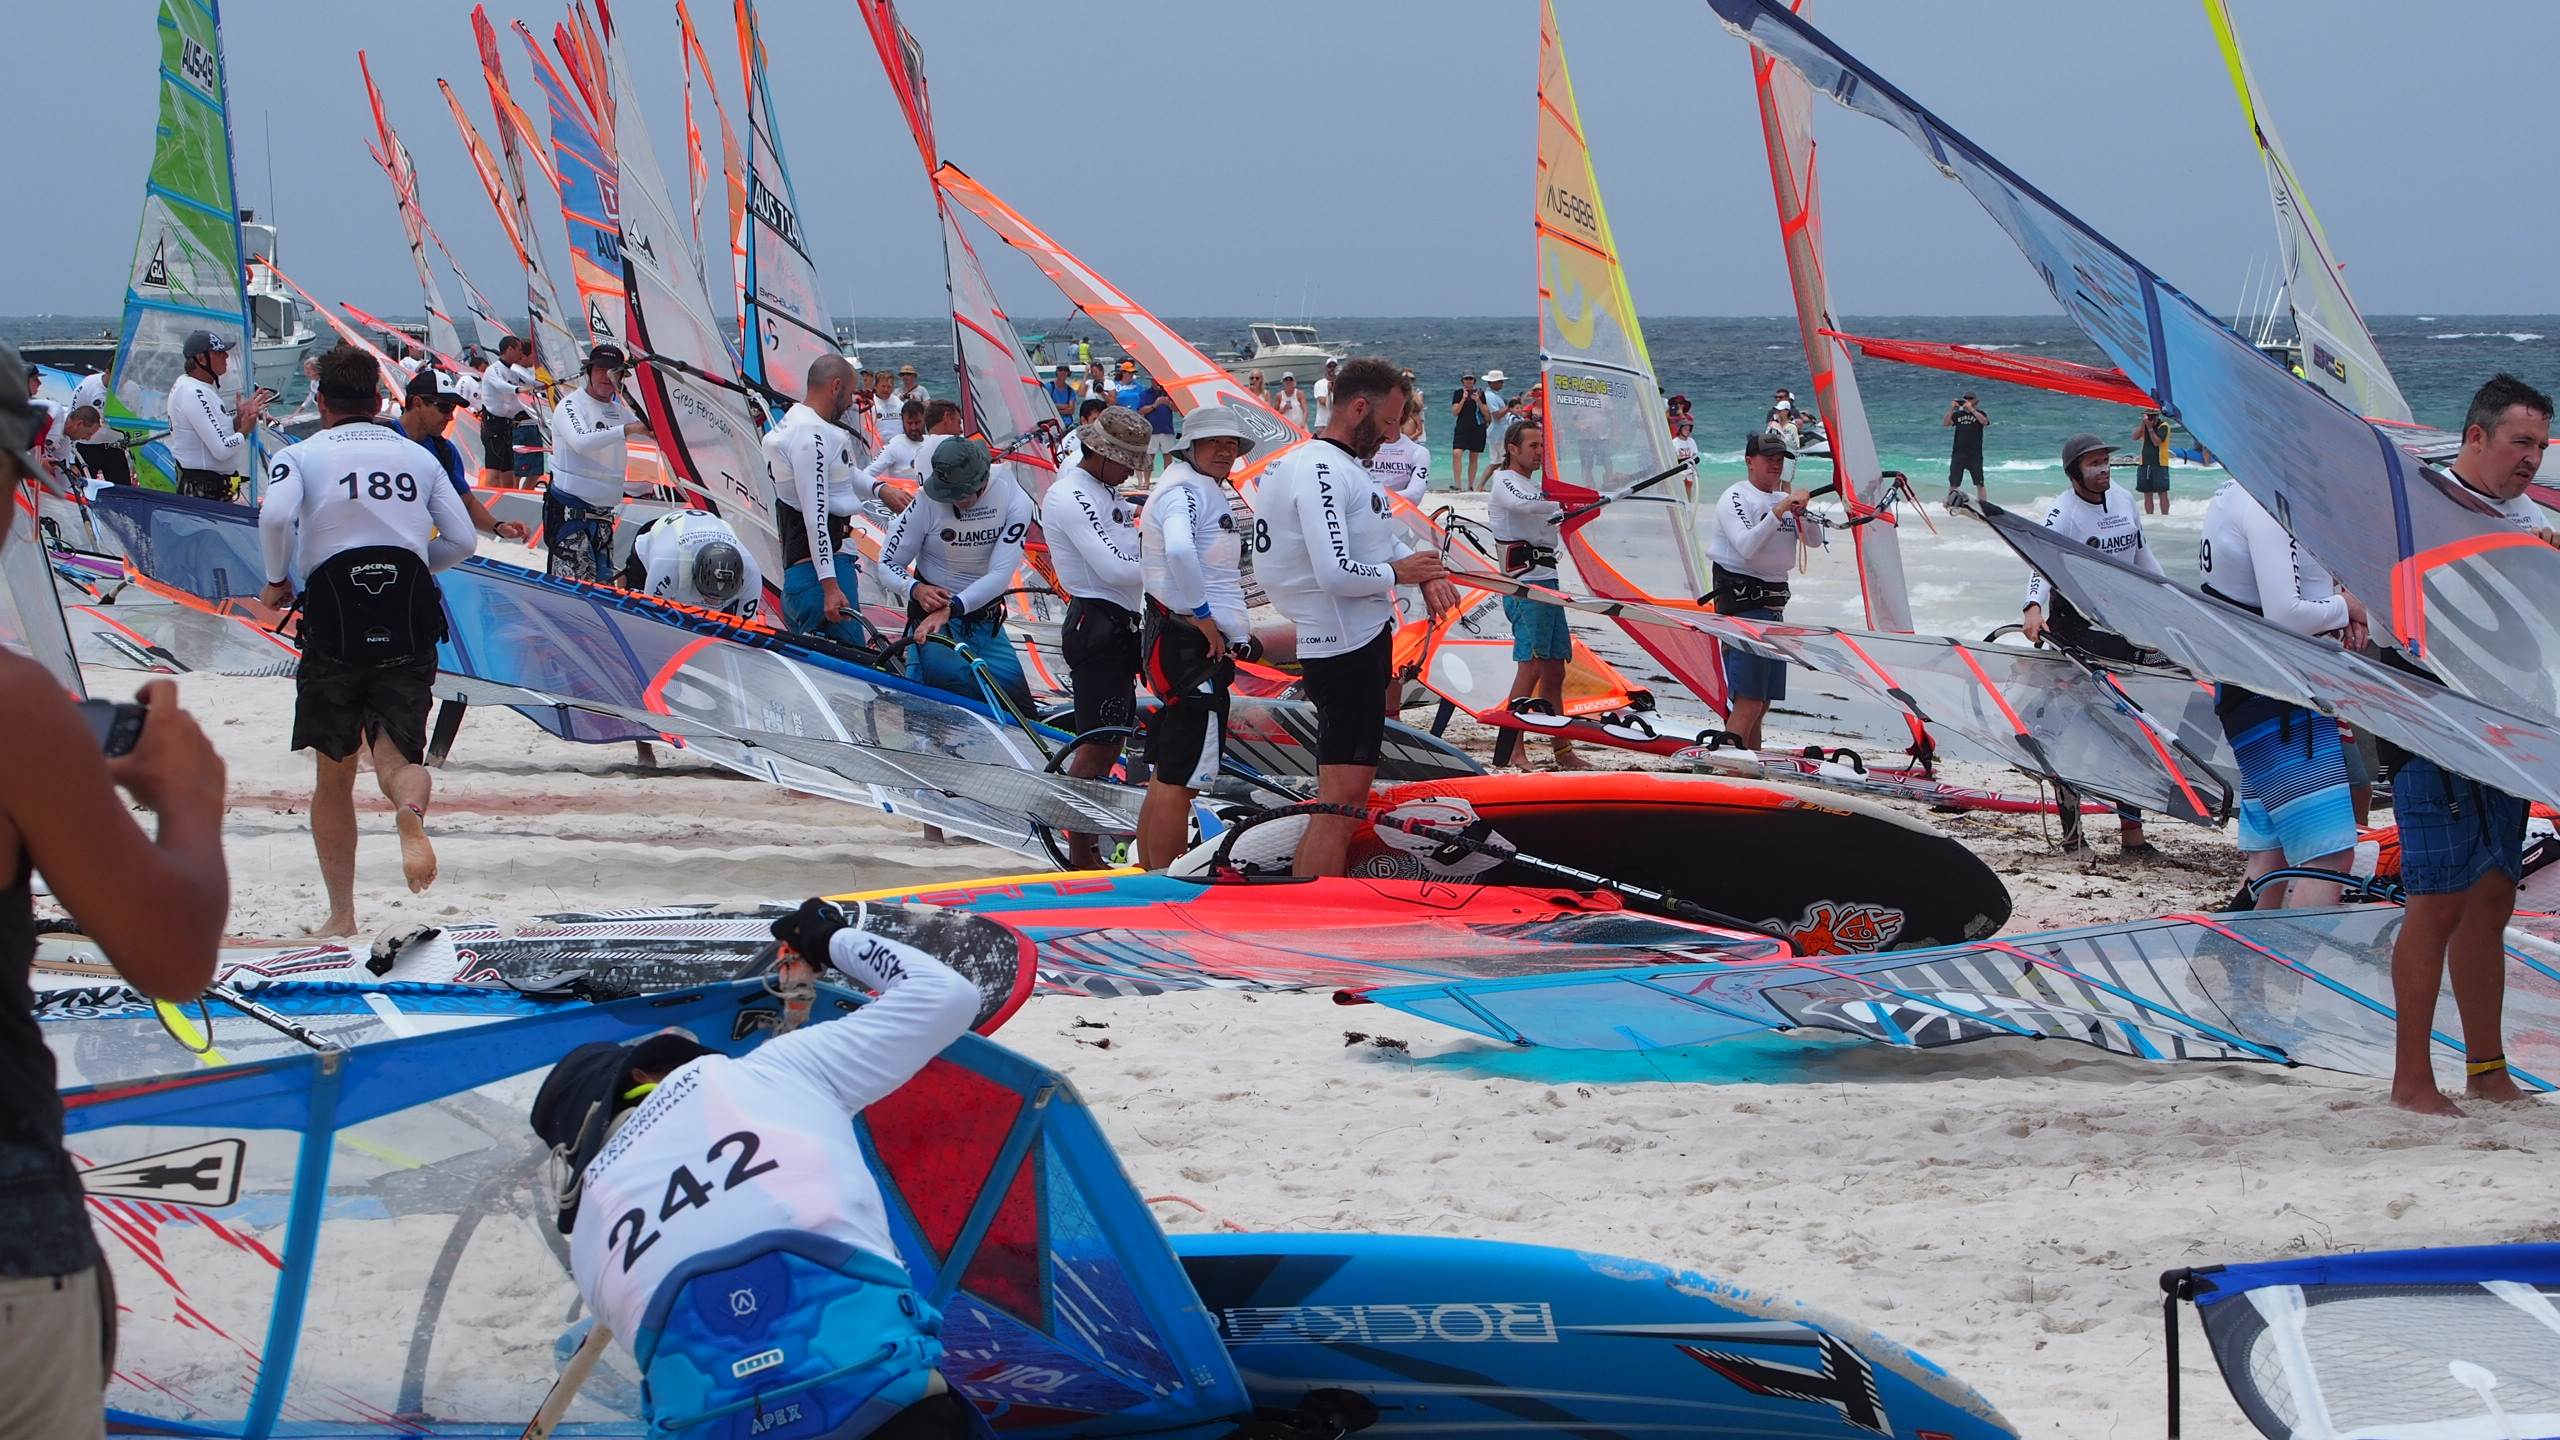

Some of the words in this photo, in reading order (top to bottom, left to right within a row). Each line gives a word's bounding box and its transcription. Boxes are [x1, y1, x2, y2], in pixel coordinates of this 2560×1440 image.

[182, 37, 213, 88] AUS-49
[754, 180, 777, 226] AUS
[778, 205, 800, 247] 714
[1546, 183, 1596, 232] AUS-888
[672, 388, 695, 415] Greg
[1556, 394, 1602, 408] NEILPRYDE
[1375, 460, 1412, 471] LANCELIN
[338, 471, 419, 503] 189
[813, 433, 830, 566] #LANCELINCLASSIC
[1255, 518, 1272, 553] 8
[351, 563, 397, 574] DAKINE
[653, 575, 672, 597] #LA
[1513, 851, 1663, 901] SEVERNE
[37, 968, 124, 981] STARBOA
[857, 938, 909, 983] ASSIC
[588, 1064, 703, 1177] XTRAORDINARY
[636, 1082, 700, 1138] AUSTRALIA
[608, 1130, 779, 1275] 242
[751, 1402, 803, 1435] APEX
